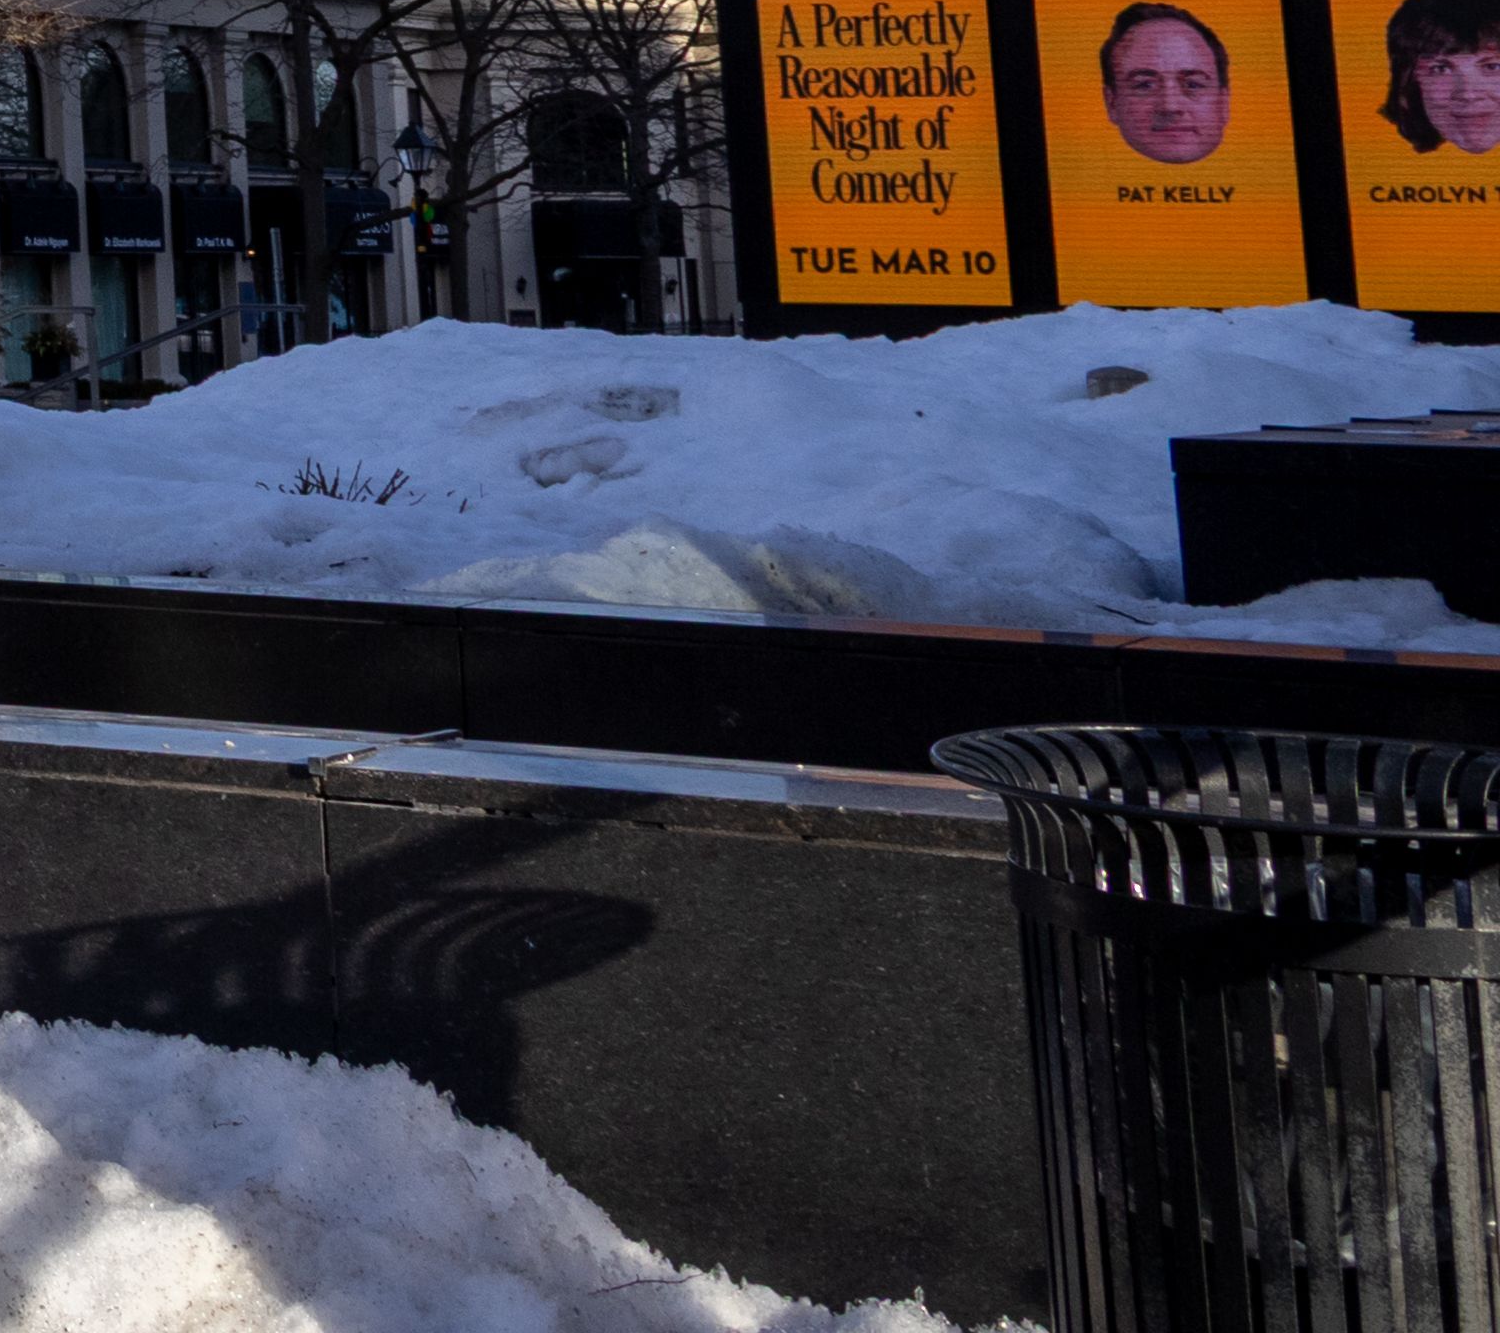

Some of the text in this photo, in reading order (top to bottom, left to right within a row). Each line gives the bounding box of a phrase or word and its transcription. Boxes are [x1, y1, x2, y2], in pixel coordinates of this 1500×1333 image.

[777, 1, 972, 56] A Perfectly
[776, 50, 976, 99] Reasonable
[808, 105, 954, 161] Night of
[811, 159, 957, 215] Comedy
[1118, 186, 1235, 203] PAT KELLY
[1369, 186, 1486, 203] CAROLYN
[790, 247, 997, 275] TUE MAR 10
